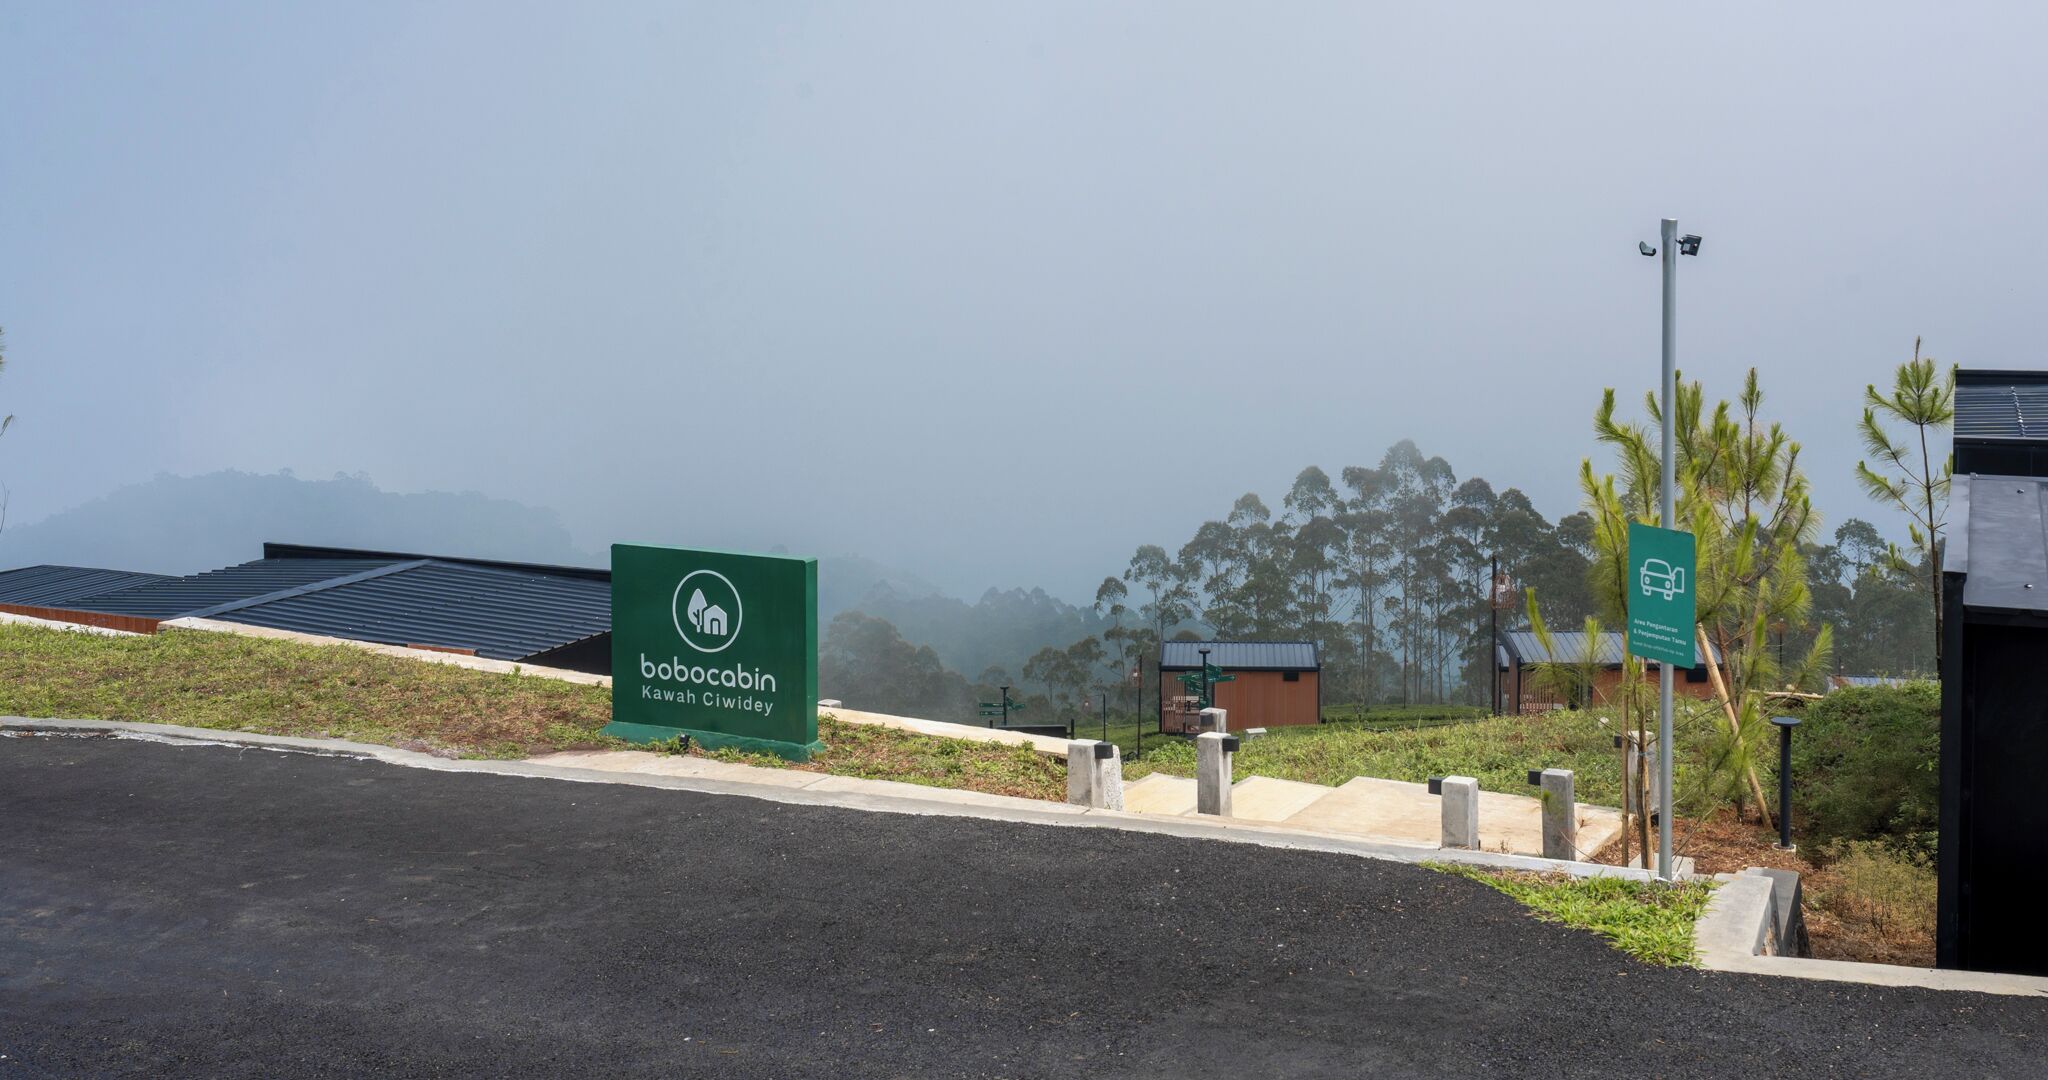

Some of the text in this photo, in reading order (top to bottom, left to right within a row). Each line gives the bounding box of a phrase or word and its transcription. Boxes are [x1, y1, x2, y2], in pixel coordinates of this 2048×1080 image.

[640, 653, 776, 692] bobocabin
[641, 685, 774, 717] Kawah Ciwidey
